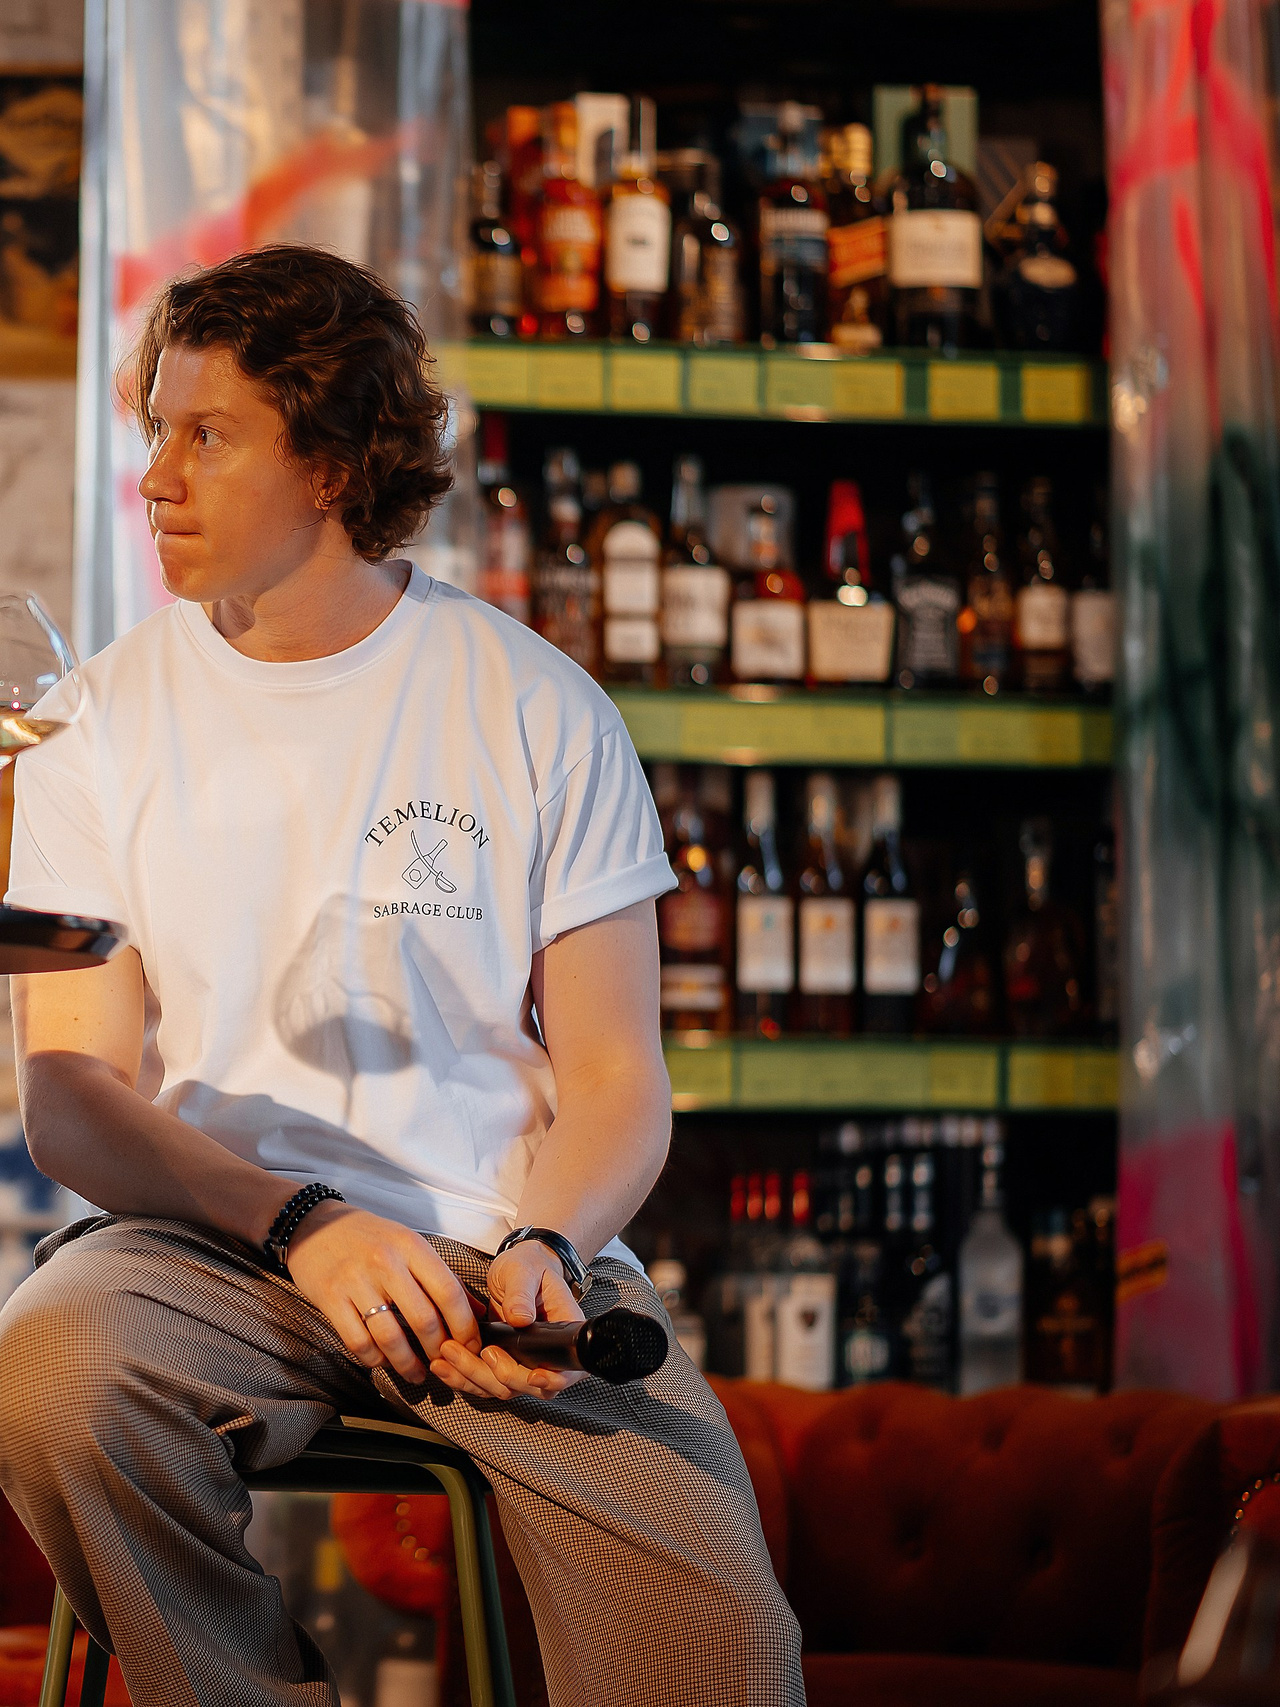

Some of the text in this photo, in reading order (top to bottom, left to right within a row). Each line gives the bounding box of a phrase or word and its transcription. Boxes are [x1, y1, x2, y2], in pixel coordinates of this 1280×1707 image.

[364, 800, 490, 849] TEMELION
[373, 901, 483, 921] SABRAGE CLUB
